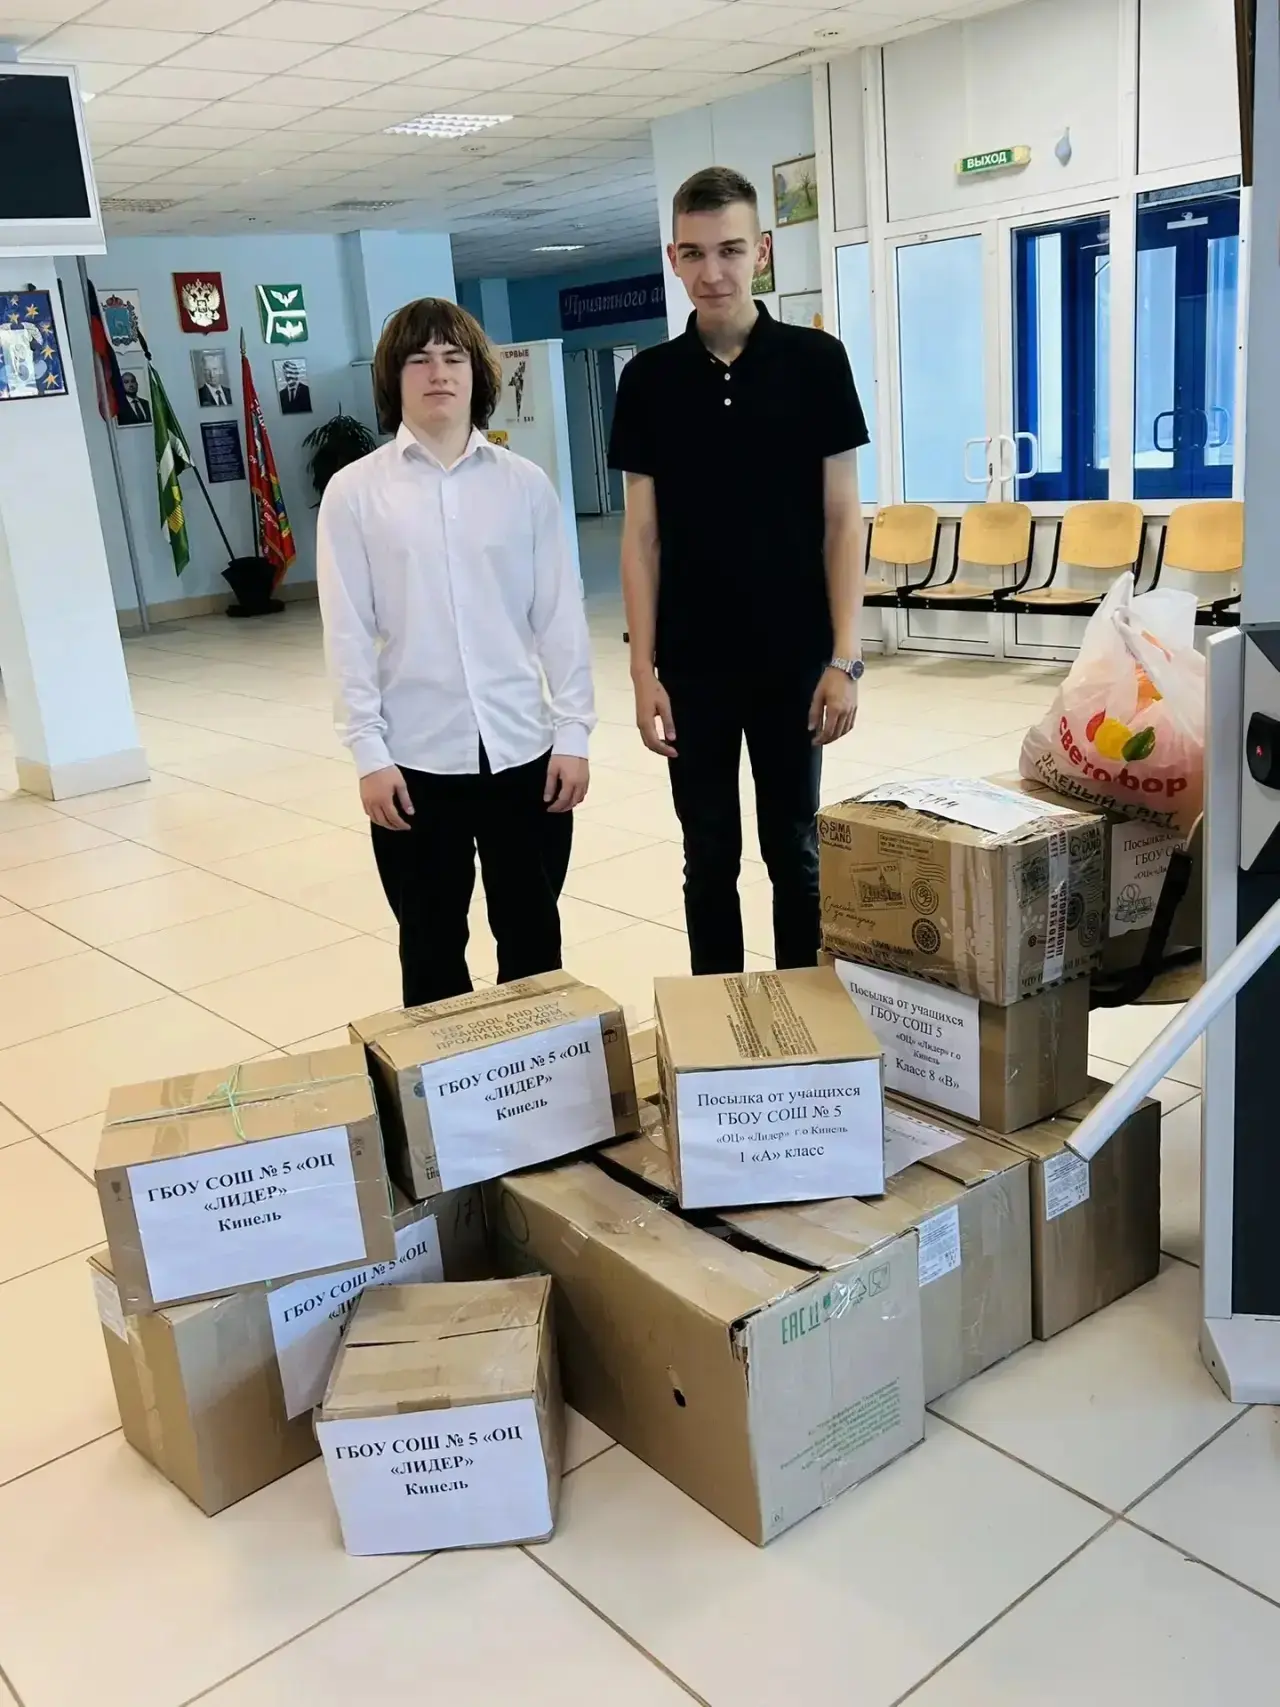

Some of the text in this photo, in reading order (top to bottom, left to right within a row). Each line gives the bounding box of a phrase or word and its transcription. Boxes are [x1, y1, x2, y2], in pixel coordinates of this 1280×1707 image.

[967, 152, 1007, 169] ВЫХОД
[564, 290, 647, 322] Приятного
[500, 349, 529, 358] ПЕРВЫЕ
[830, 821, 852, 834] SIMA
[830, 832, 852, 844] LAND
[1135, 848, 1164, 866] ГБОУ
[849, 981, 965, 1027] Посылка от учащихся
[430, 1001, 560, 1037] KEEP COOL AND DRY
[443, 1024, 502, 1040] ХРАНИТЬ
[517, 1008, 563, 1024] СУХОМ
[870, 1004, 943, 1038] ГБОУ СОШ 5
[436, 1024, 533, 1050] ПРОХЛАДНОМ
[438, 1041, 591, 1097] ГБОУ СОШ № 5 «ОЦ
[912, 1049, 941, 1066] Кинель
[895, 1057, 960, 1090] Класс 8 «В»
[484, 1074, 553, 1103] «ЛИДЕР»
[697, 1086, 861, 1107] Посылка от учащихся
[496, 1097, 548, 1121] Кинель
[717, 1105, 842, 1126] ГБОУ СОШ № 5
[716, 1133, 745, 1144] «ОЦ»
[747, 1130, 789, 1143] «Лидер»
[811, 1125, 848, 1135] Кинель
[740, 1145, 824, 1163] 1 «А» класс
[148, 1153, 335, 1202] ГБОУ СОШ № 5 «ОЦ
[204, 1186, 287, 1212] «ЛИДЕР»
[218, 1211, 282, 1232] Кинель
[283, 1291, 326, 1323] ГБОУ
[330, 1271, 368, 1299] СОШ
[371, 1264, 386, 1280] №
[399, 1241, 428, 1264] «ОЦ
[335, 1425, 522, 1459] ГБОУ СОШ № 5 «ОЦ
[391, 1455, 474, 1475] «ЛИДЕР»
[405, 1480, 469, 1496] Кинель
